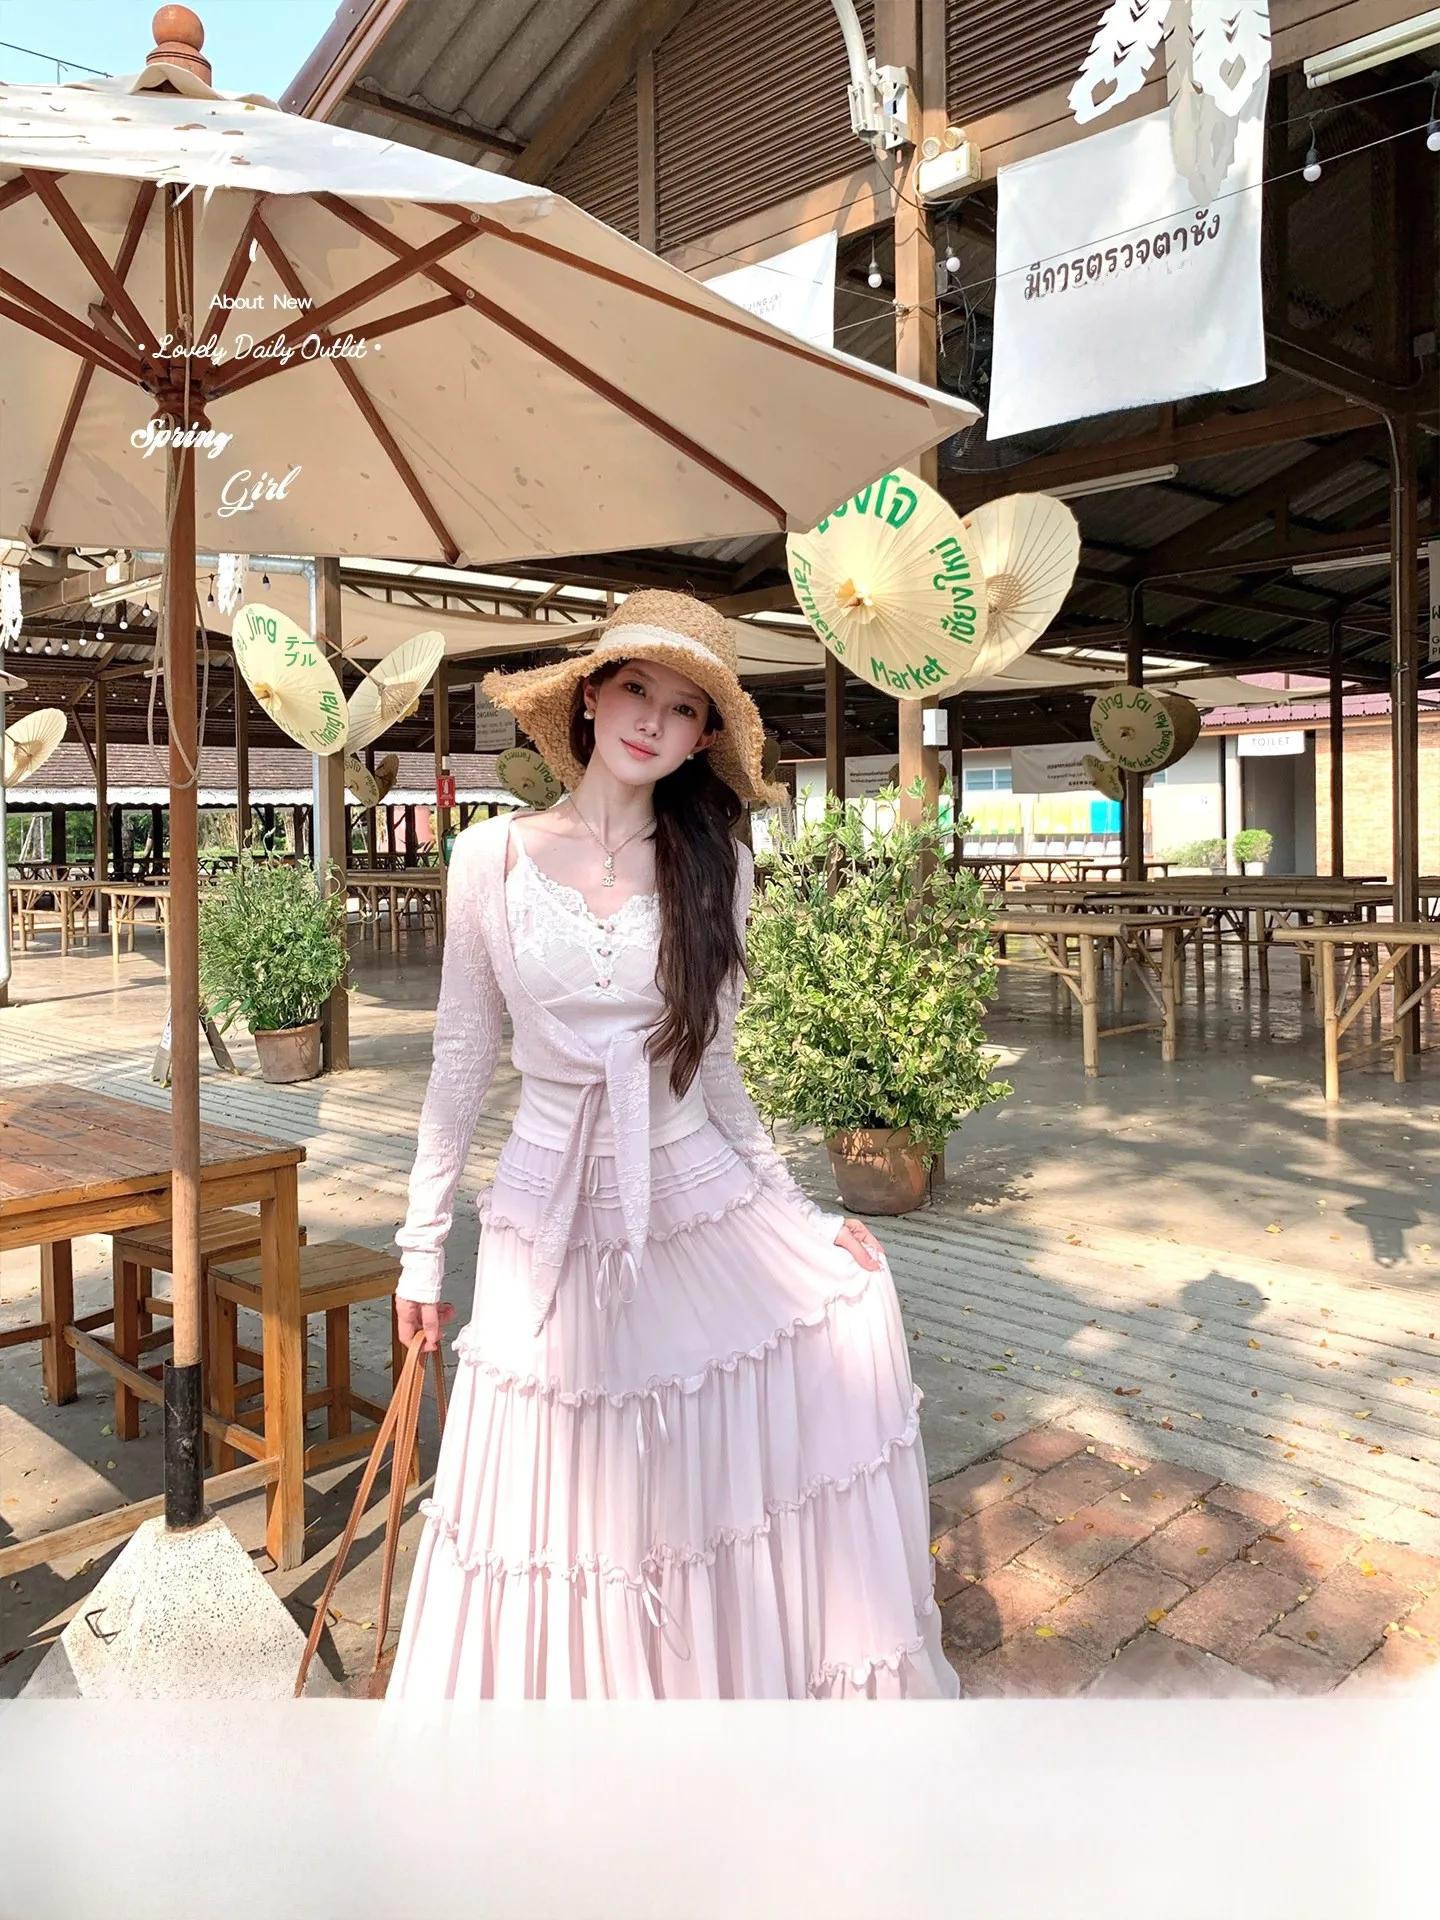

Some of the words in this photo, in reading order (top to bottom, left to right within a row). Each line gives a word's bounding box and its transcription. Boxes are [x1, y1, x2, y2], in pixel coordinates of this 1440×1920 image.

[791, 549, 846, 656] Farmers
[870, 654, 949, 690] Market
[318, 690, 342, 717] Mai
[1097, 692, 1123, 720] Jing
[1127, 692, 1152, 713] Jai
[310, 716, 345, 747] Chiang
[1152, 711, 1169, 729] Mai
[1092, 720, 1116, 759] Farmers
[1150, 730, 1173, 759] Chiang
[1252, 736, 1290, 746] TOILET
[1118, 755, 1155, 769] Market
